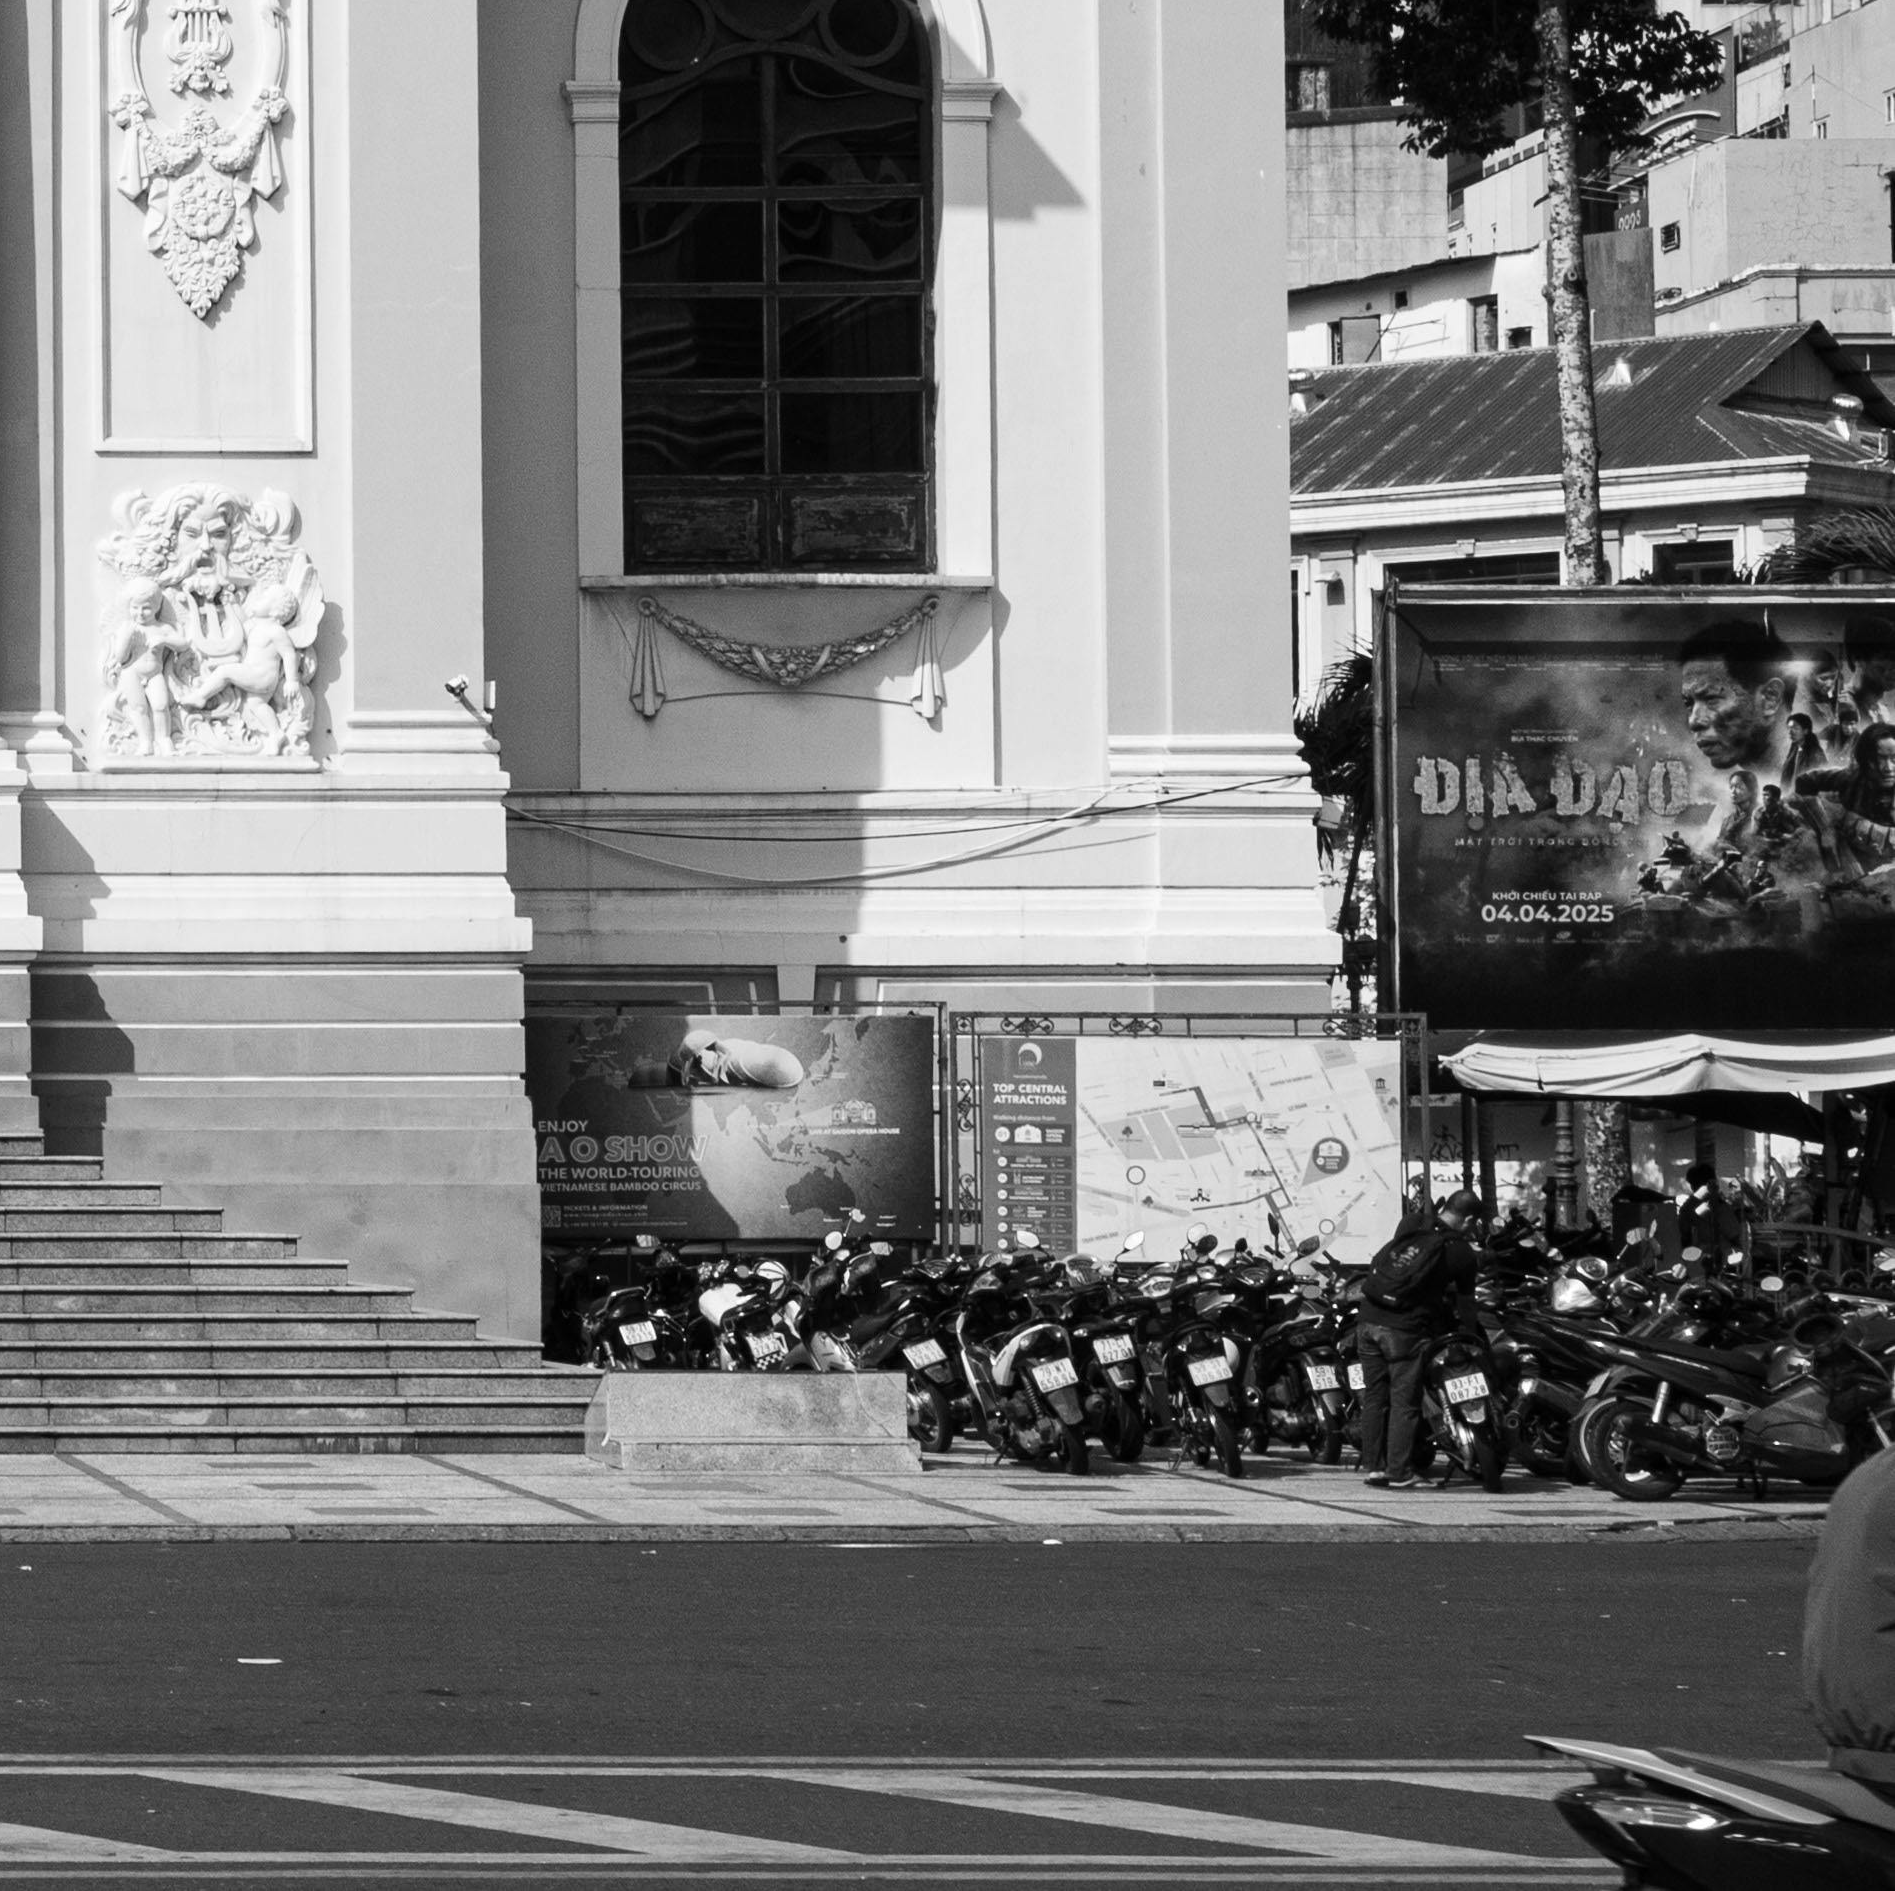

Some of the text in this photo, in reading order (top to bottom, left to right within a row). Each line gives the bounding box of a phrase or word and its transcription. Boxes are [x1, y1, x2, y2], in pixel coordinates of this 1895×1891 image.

[1550, 755, 1689, 834] ĐẠO
[1481, 905, 1614, 923] 04.04.2025
[993, 1083, 1067, 1094] TOP CENTRAL
[993, 1094, 1067, 1106] ATTRACTIONS
[538, 1119, 589, 1133] ENJOY
[538, 1134, 710, 1163] A O SHOW
[539, 1166, 700, 1180] THE WORLD-TOURING
[541, 1181, 702, 1192] VIETNAMESE BAMBOO CIRCUS
